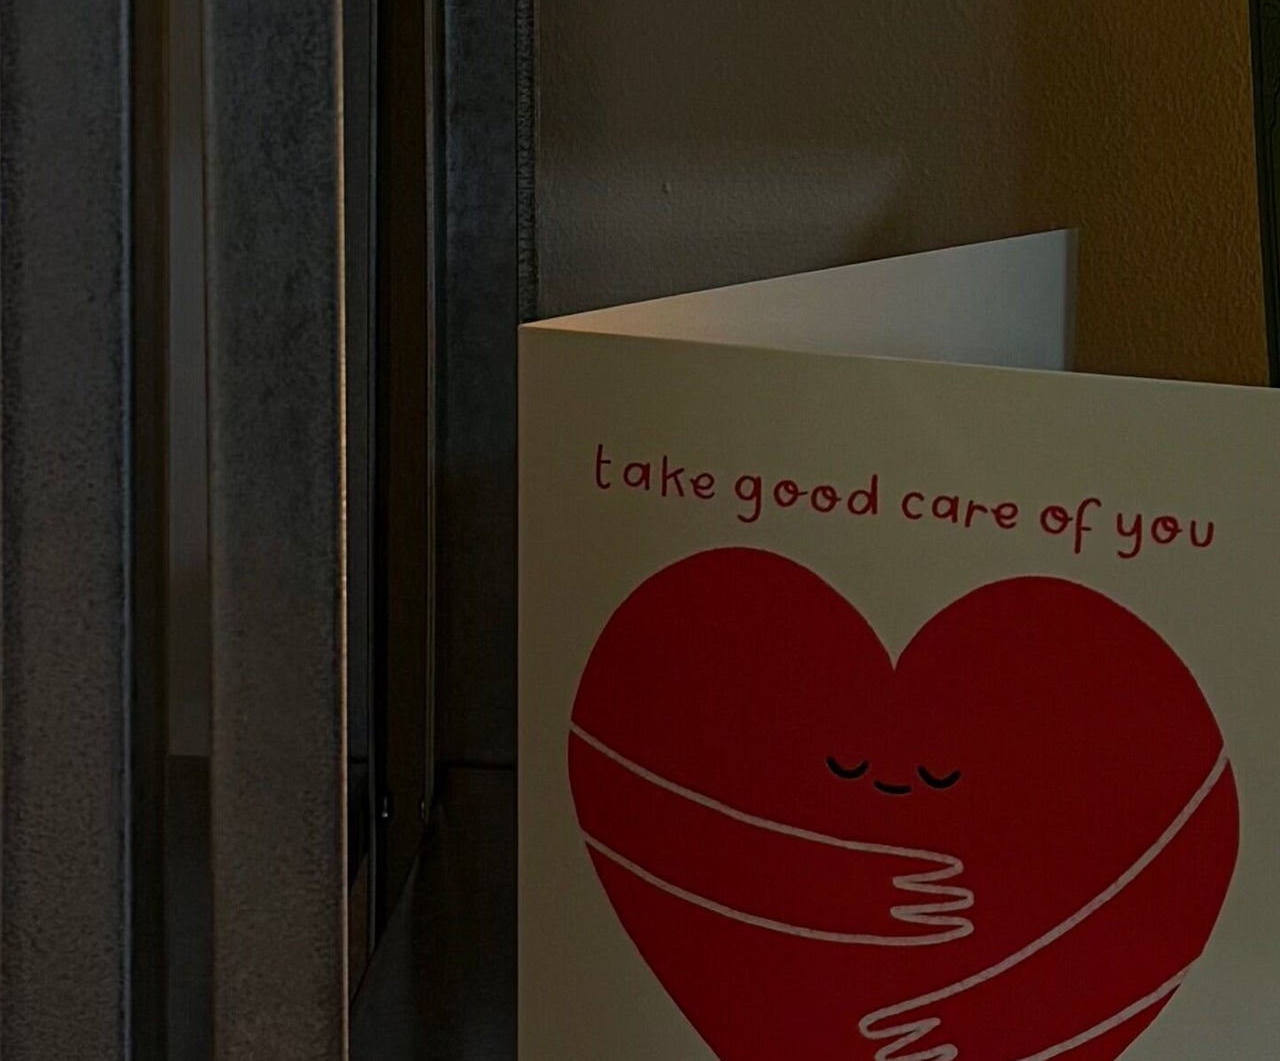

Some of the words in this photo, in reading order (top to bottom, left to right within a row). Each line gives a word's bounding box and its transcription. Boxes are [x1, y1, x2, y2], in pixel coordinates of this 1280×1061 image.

[595, 442, 717, 500] take
[733, 473, 881, 523] good
[900, 488, 1020, 531] care
[1039, 496, 1103, 555] of
[1114, 509, 1217, 559] you
